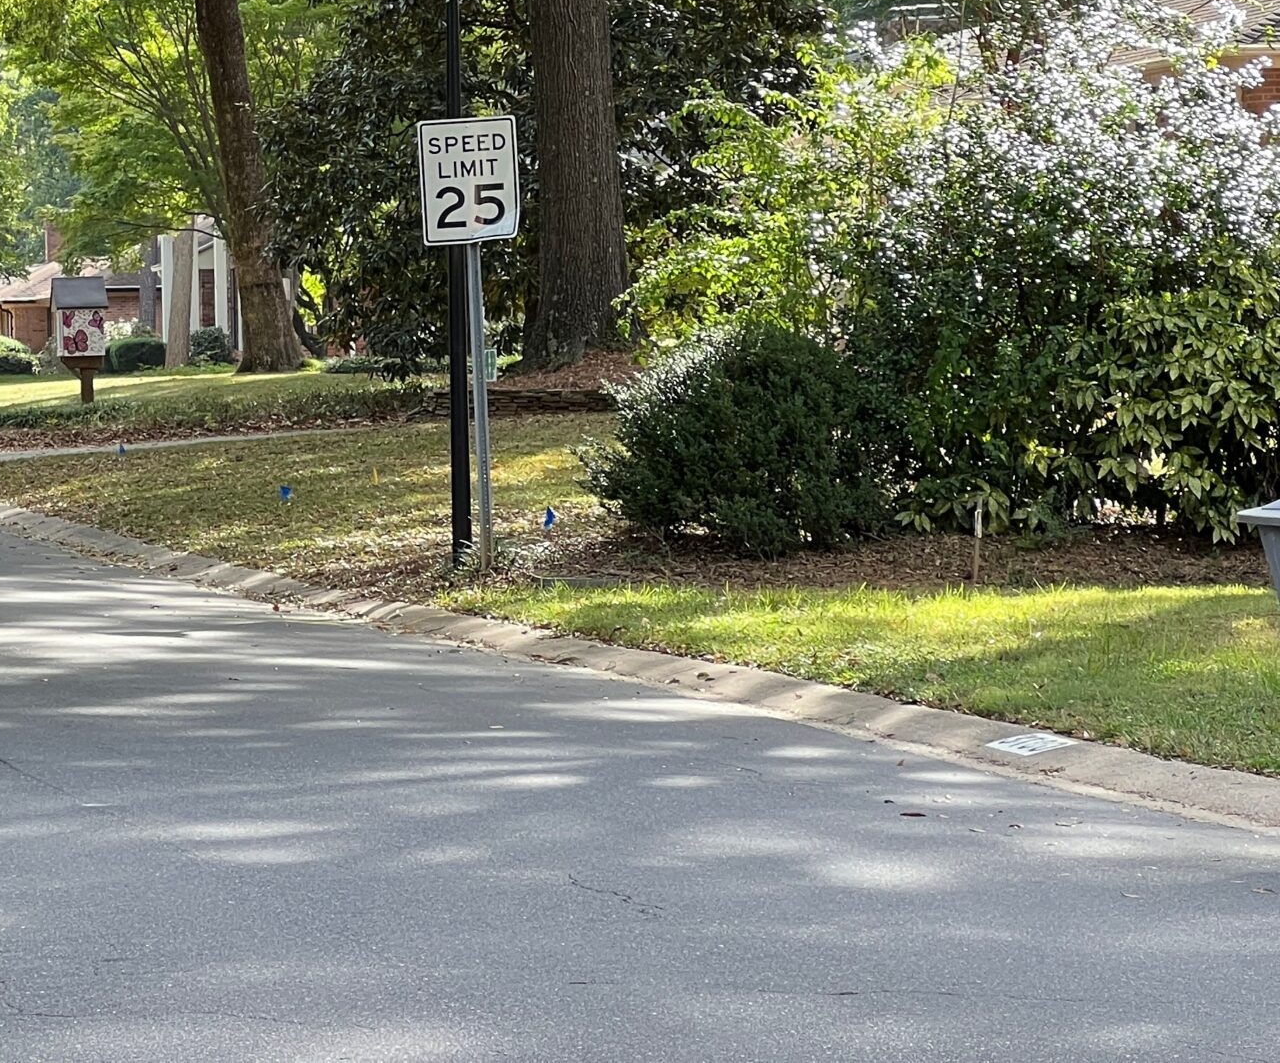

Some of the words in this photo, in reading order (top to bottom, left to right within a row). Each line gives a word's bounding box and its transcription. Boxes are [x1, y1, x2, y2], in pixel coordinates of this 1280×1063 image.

[428, 133, 506, 155] SPEED
[438, 158, 498, 179] LIMIT
[435, 182, 506, 229] 25
